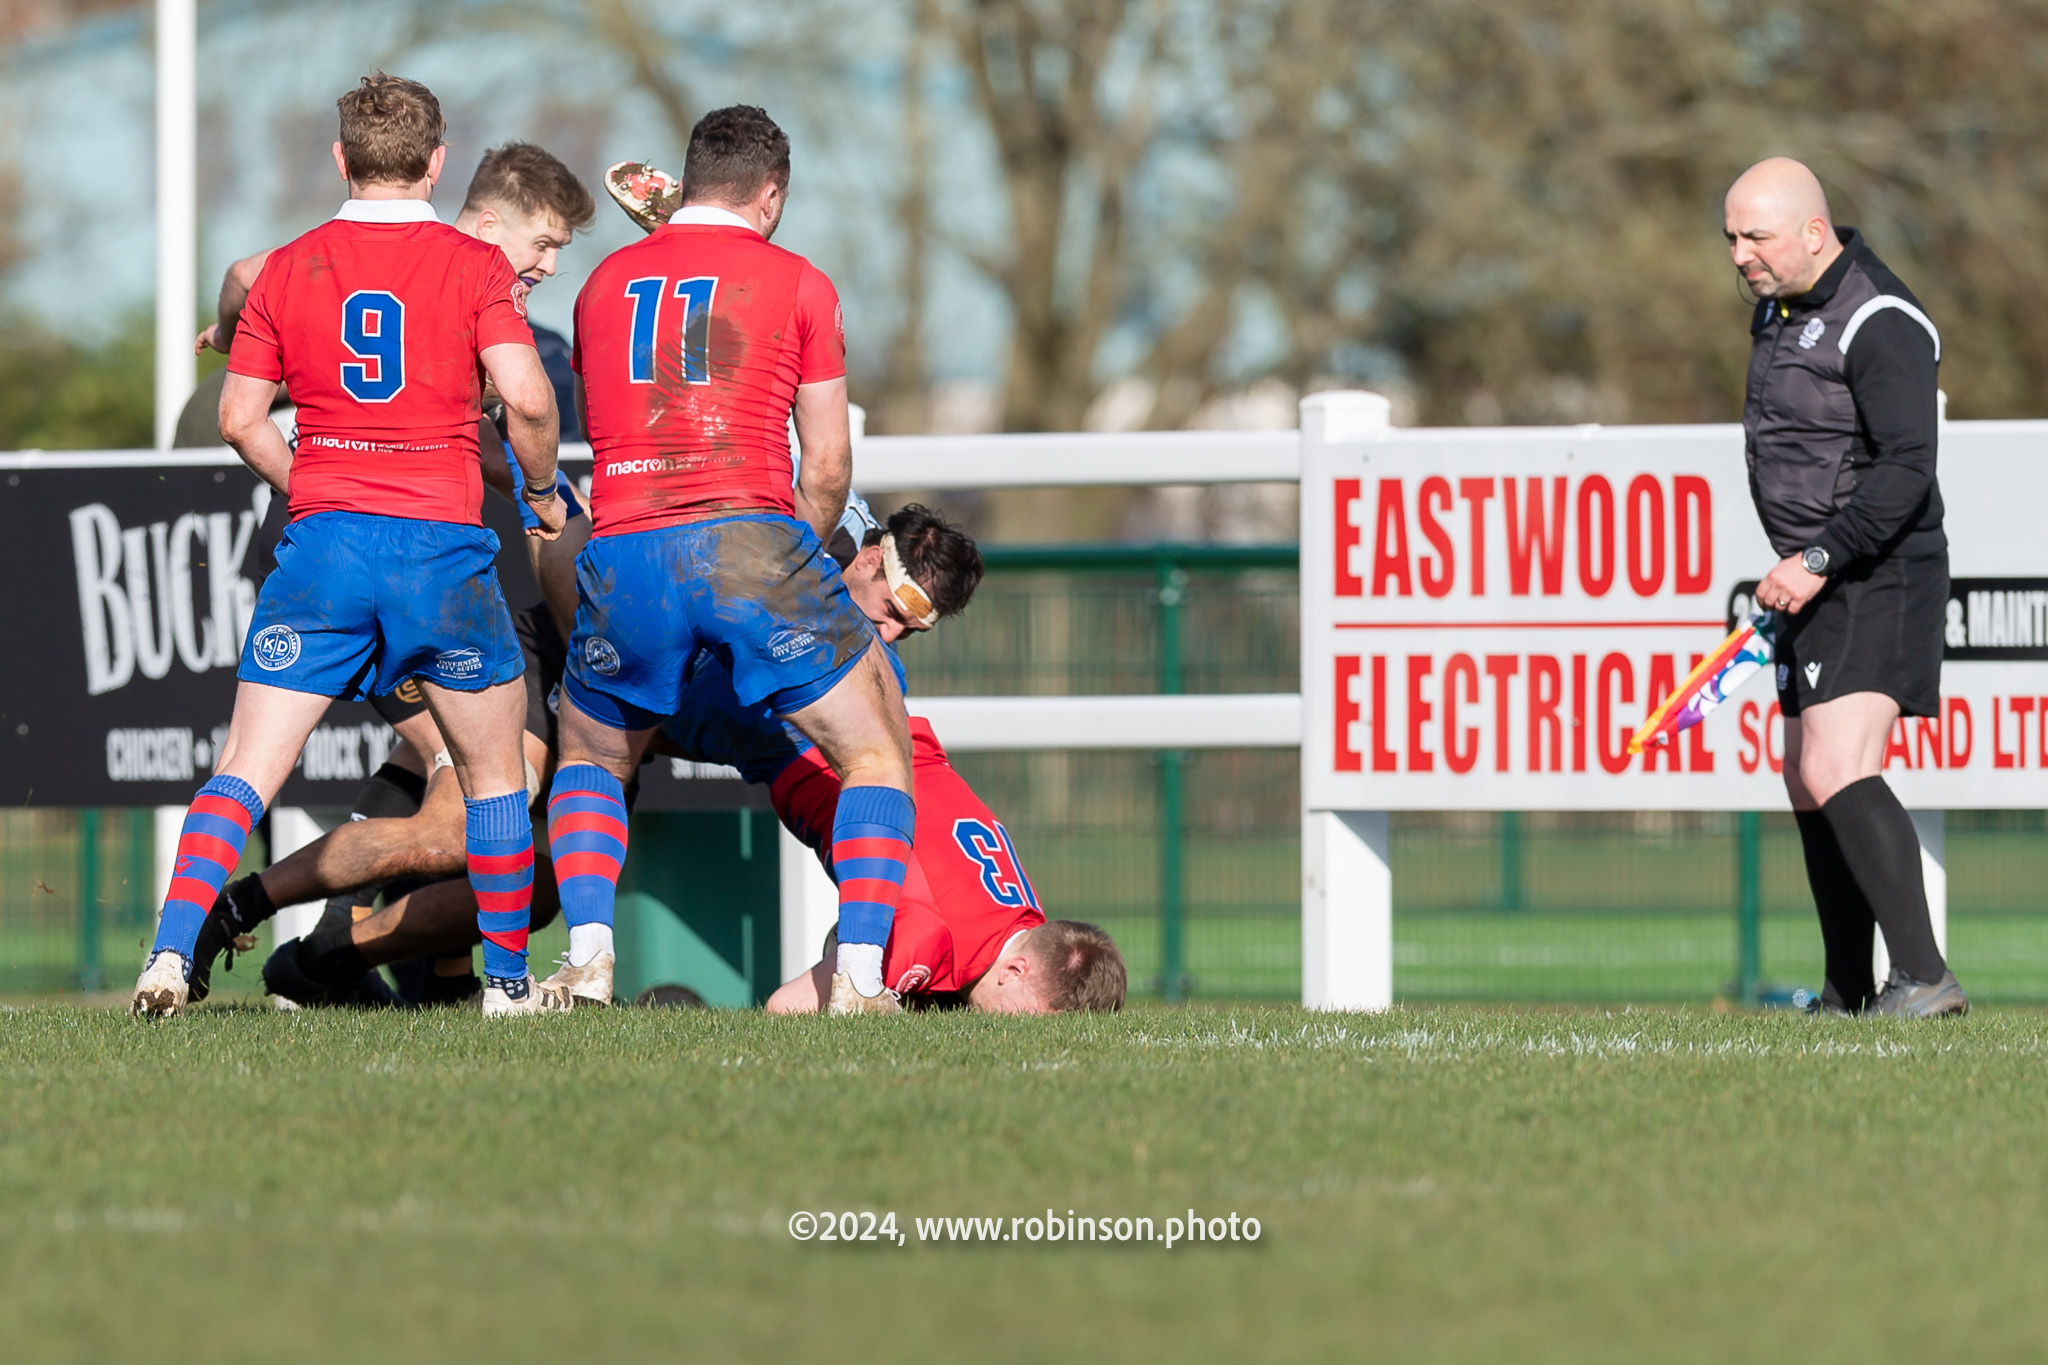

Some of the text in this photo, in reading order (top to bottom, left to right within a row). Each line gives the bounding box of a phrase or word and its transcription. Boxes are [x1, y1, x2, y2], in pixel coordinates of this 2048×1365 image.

[339, 290, 406, 403] 9
[624, 276, 719, 386] 11
[606, 458, 674, 477] macron
[1333, 473, 1712, 598] EASTWOOD
[1967, 590, 2048, 648] MAINT
[106, 727, 194, 781] CHICKEN
[1333, 652, 1714, 774] ELECTRICAL
